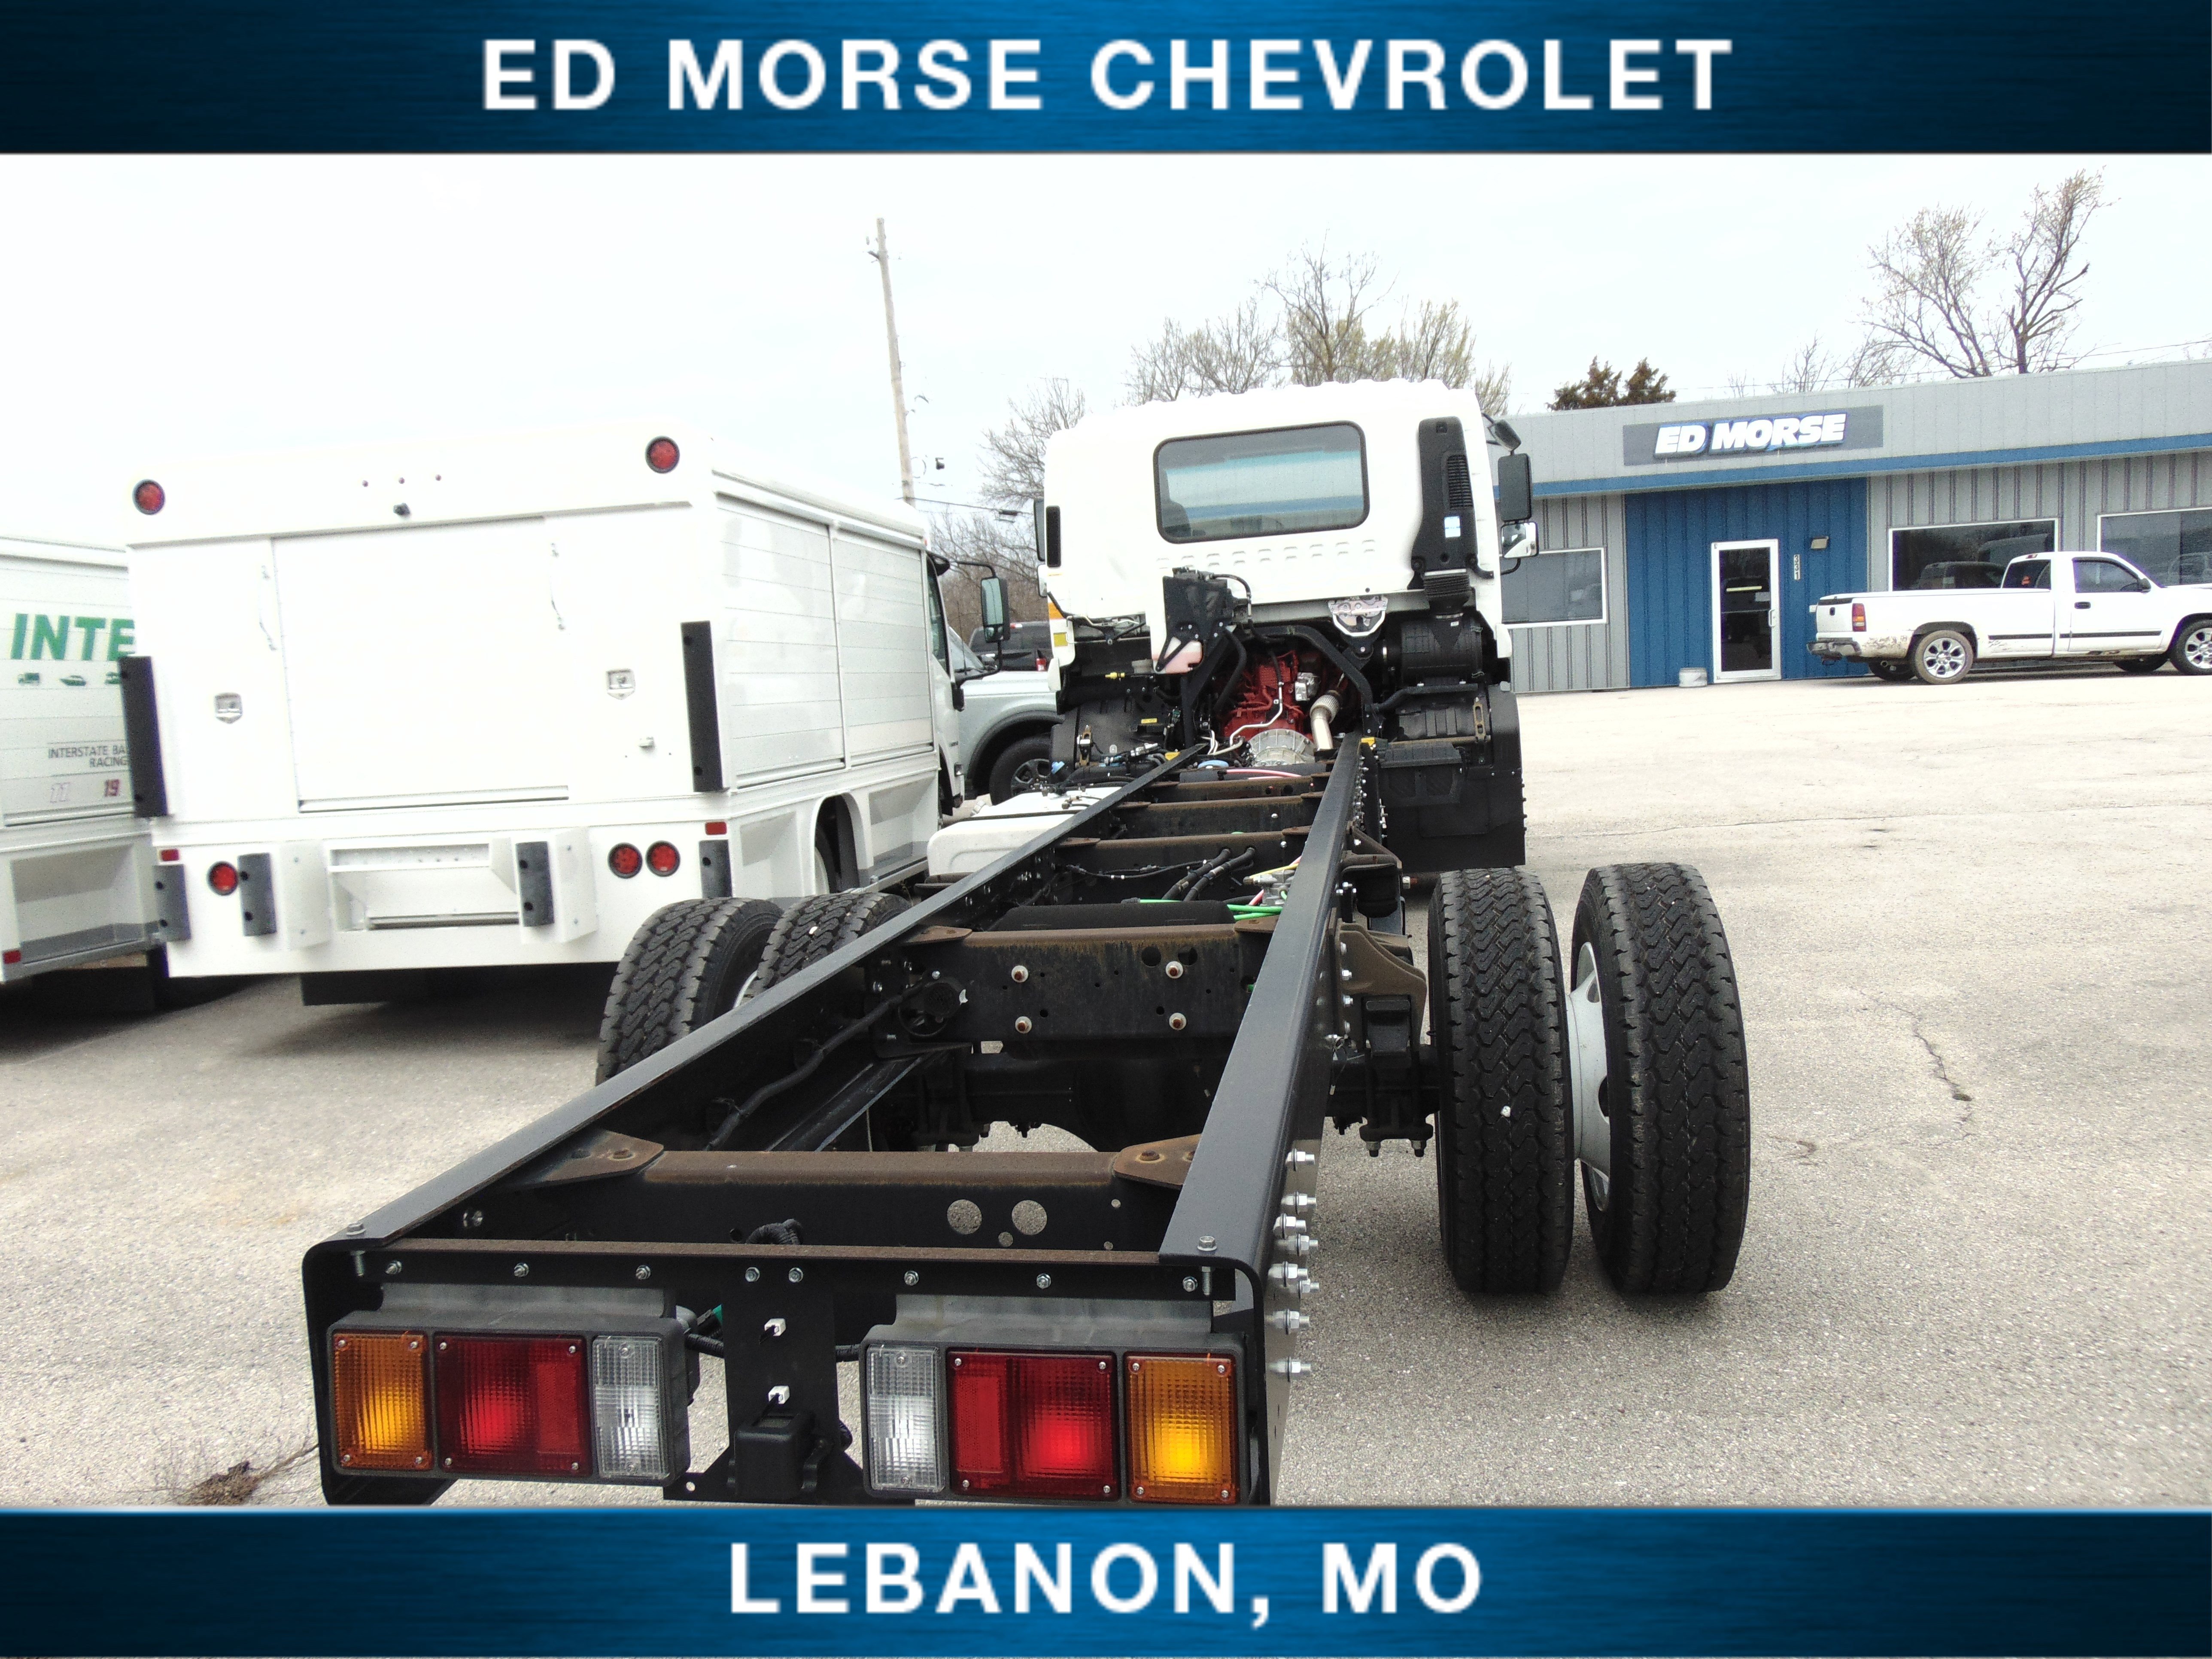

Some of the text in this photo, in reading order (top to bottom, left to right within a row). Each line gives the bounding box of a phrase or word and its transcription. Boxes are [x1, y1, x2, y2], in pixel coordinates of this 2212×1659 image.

[1655, 413, 1846, 455] ED MORSE
[10, 613, 136, 661] INTE
[48, 746, 108, 759] INTERSTATE
[89, 756, 128, 768] RACING
